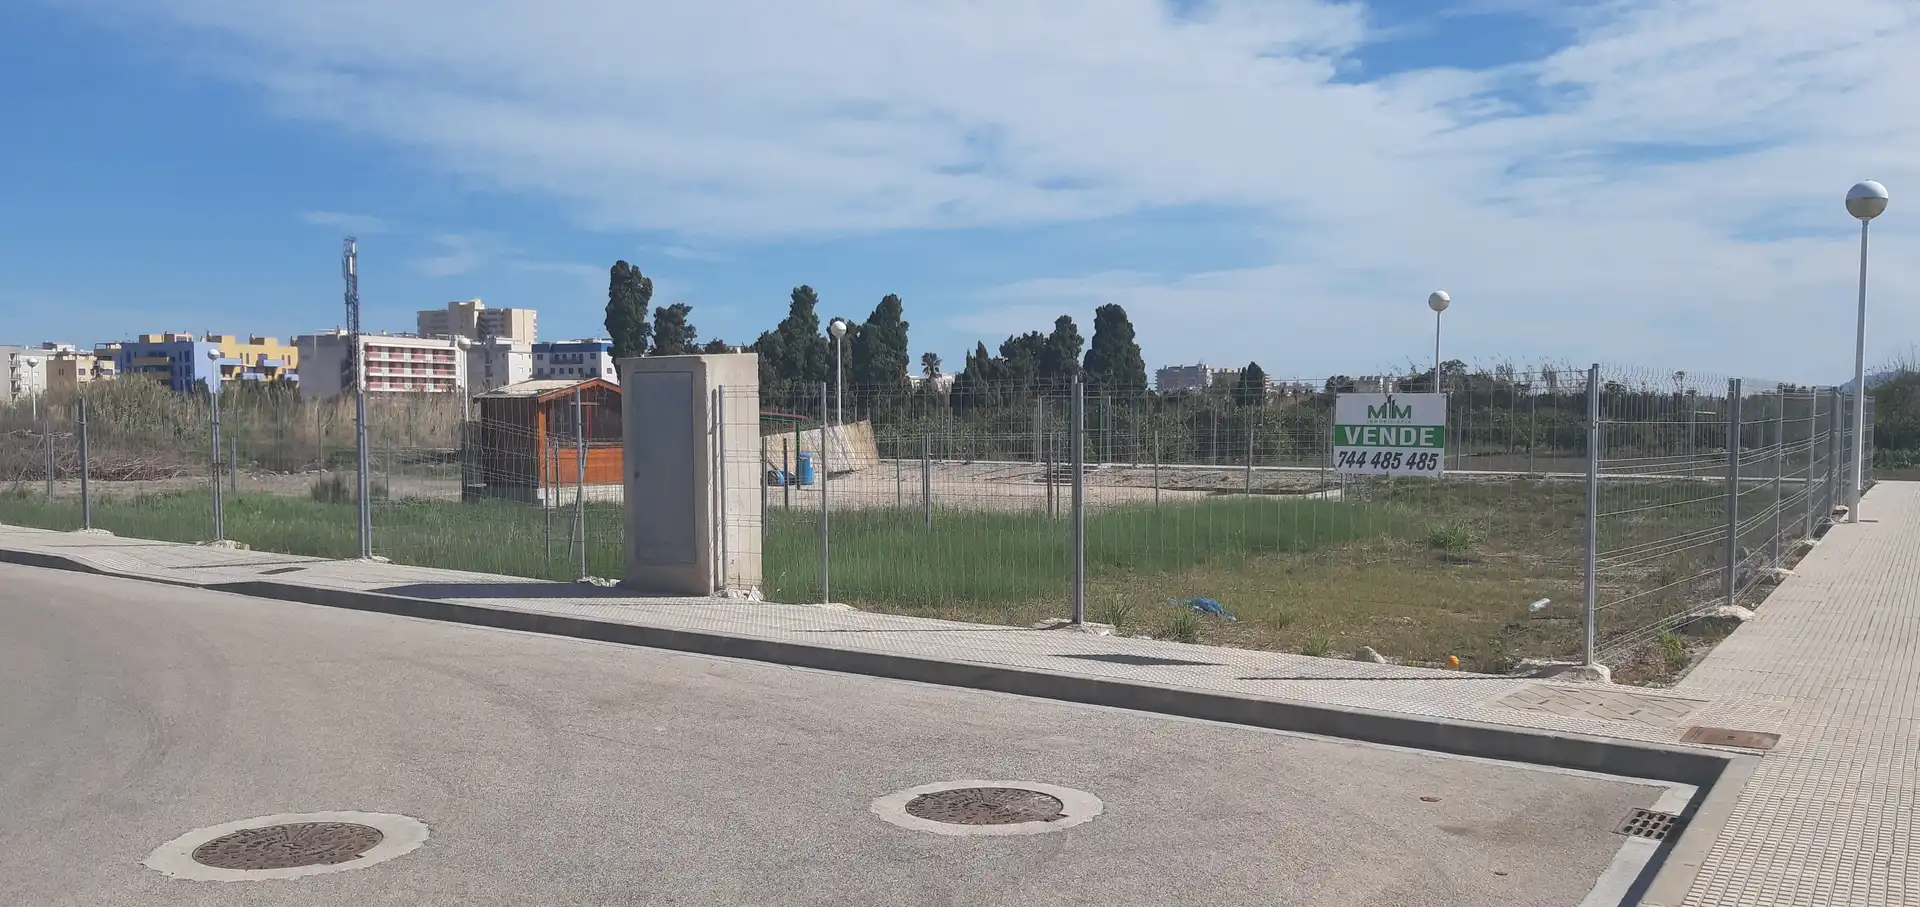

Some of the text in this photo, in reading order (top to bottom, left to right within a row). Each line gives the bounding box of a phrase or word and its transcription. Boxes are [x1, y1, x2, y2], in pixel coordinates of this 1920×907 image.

[1344, 426, 1435, 446] VENDE
[1338, 451, 1439, 471] 744 485 485
